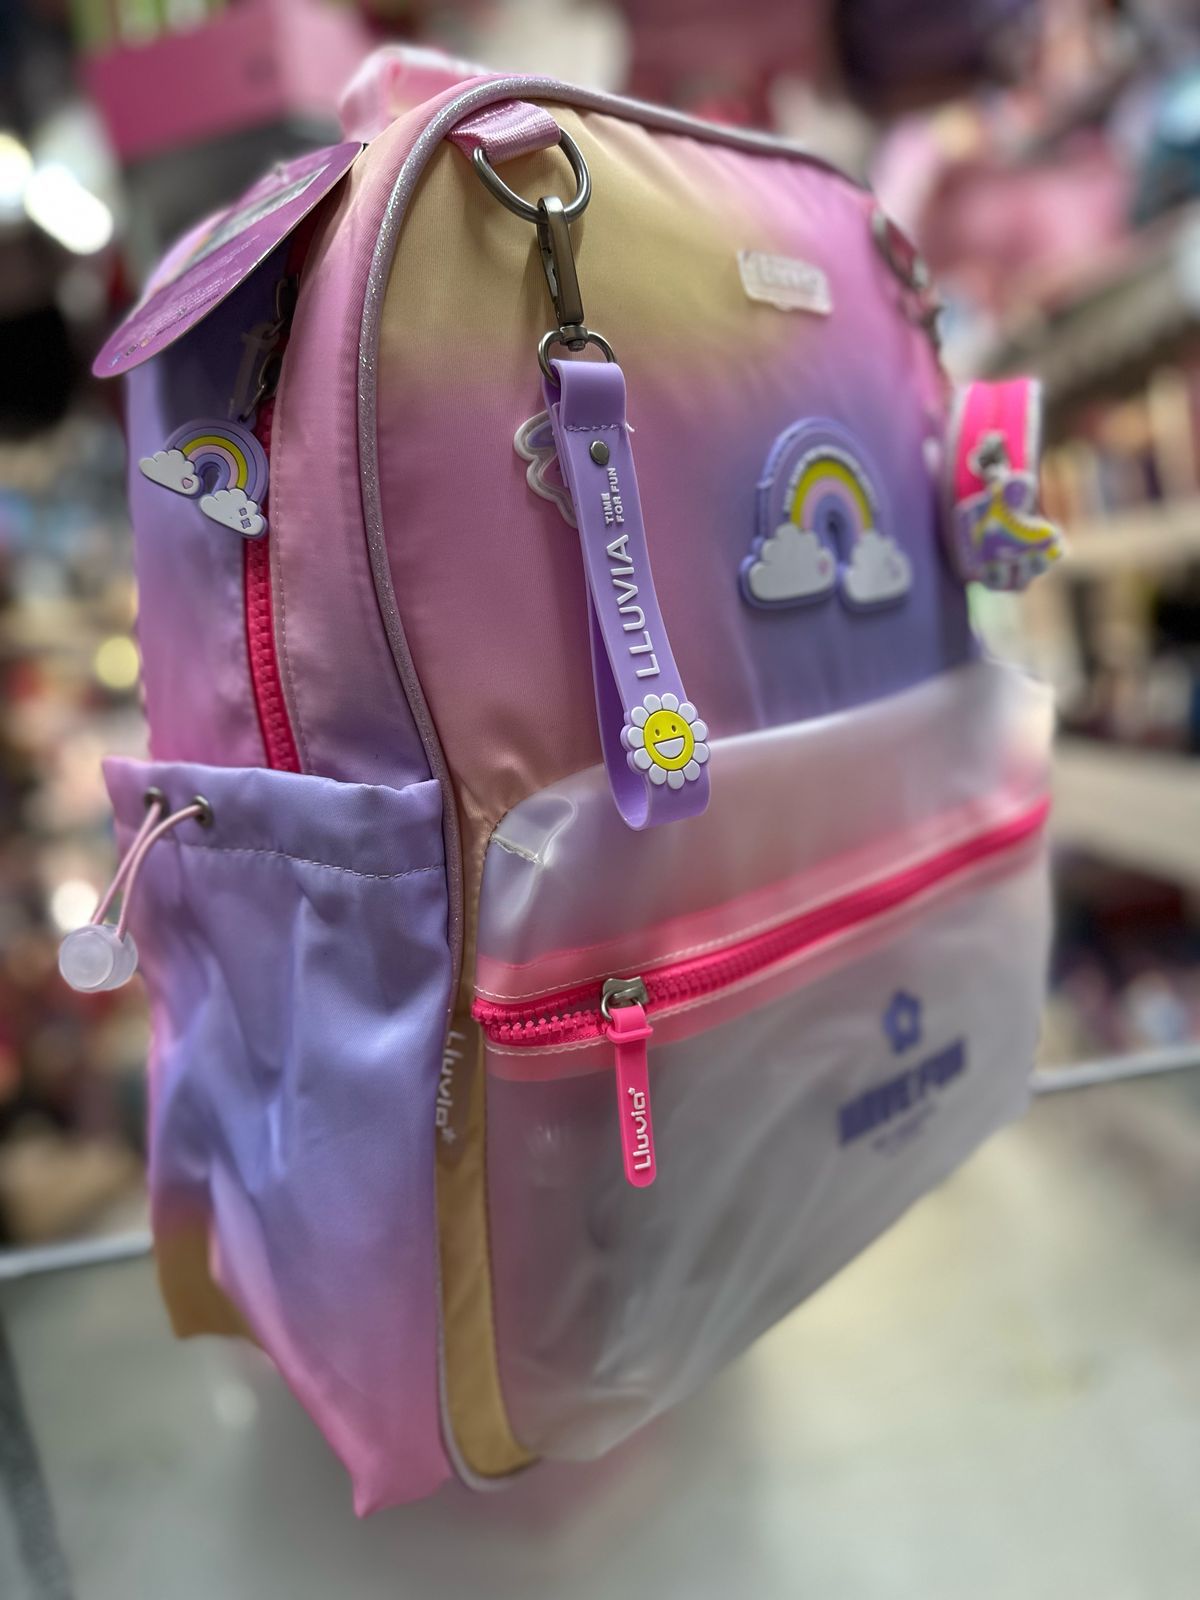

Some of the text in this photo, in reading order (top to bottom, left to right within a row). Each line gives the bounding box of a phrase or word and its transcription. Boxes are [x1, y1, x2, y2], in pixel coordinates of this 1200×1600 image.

[601, 492, 614, 524] TIME
[607, 467, 625, 522] FOR FUN
[606, 534, 661, 678] LLUVIA
[631, 1091, 651, 1169] Lluvia
